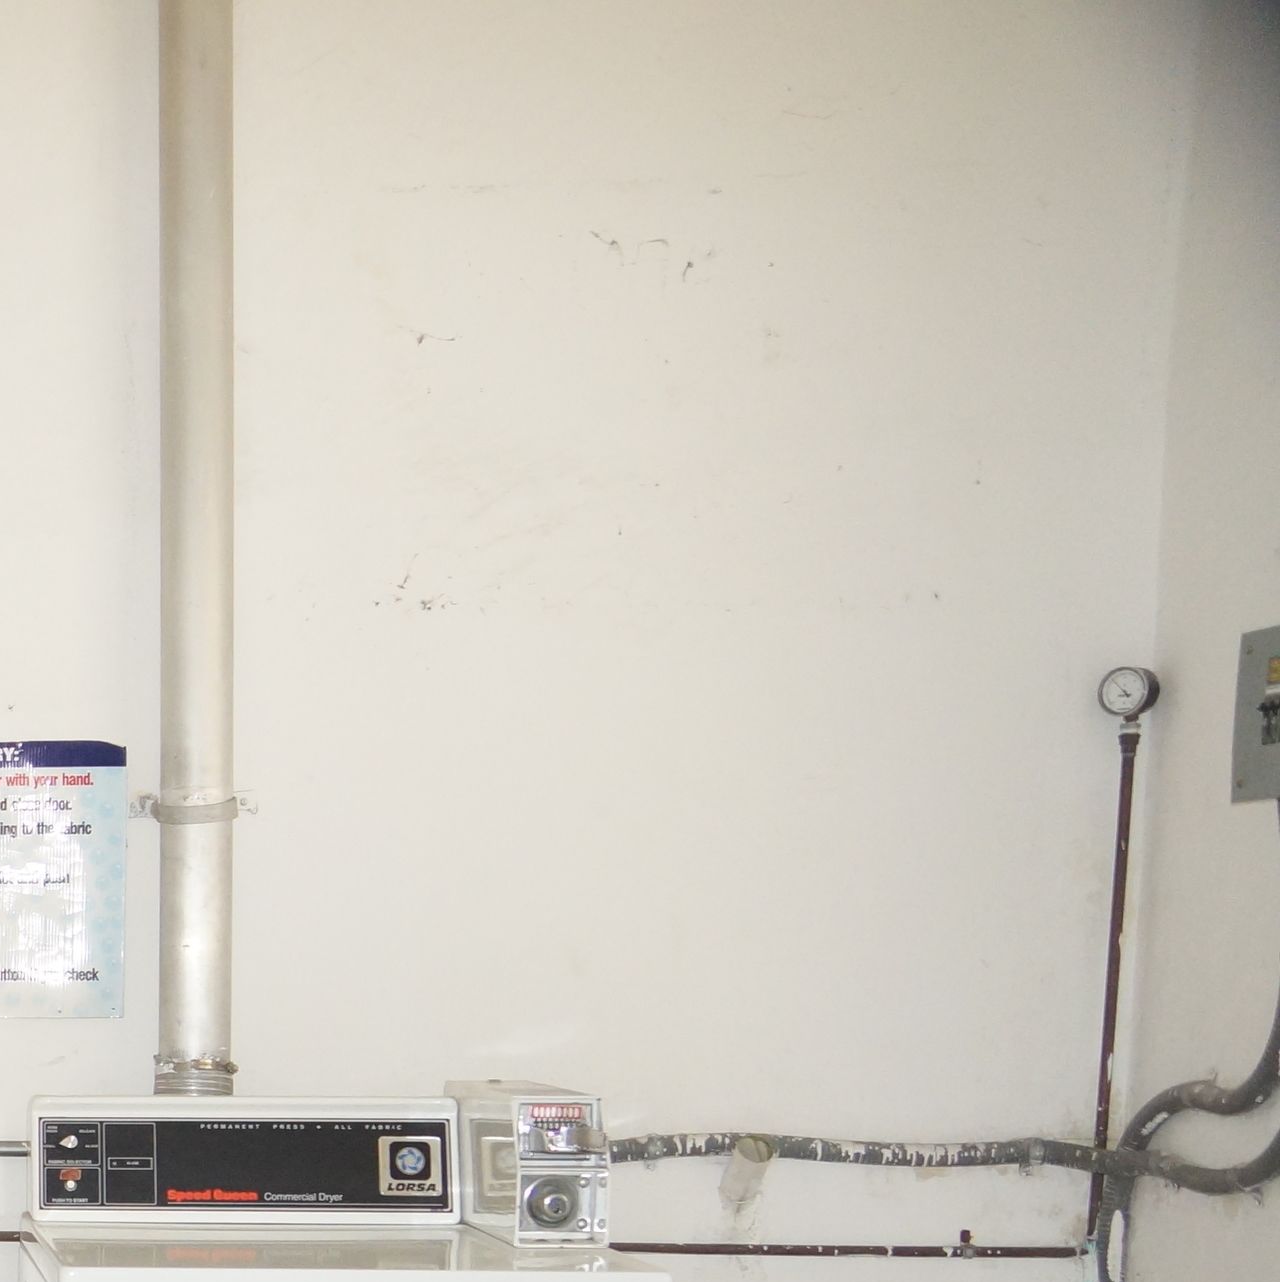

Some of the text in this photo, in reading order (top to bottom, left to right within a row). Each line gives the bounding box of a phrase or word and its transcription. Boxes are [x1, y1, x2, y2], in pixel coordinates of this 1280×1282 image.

[6, 773, 29, 786] with
[63, 772, 93, 785] hand.
[387, 1183, 437, 1192] LORSA
[264, 1192, 317, 1201] Commercial
[318, 1192, 343, 1202] Dryer
